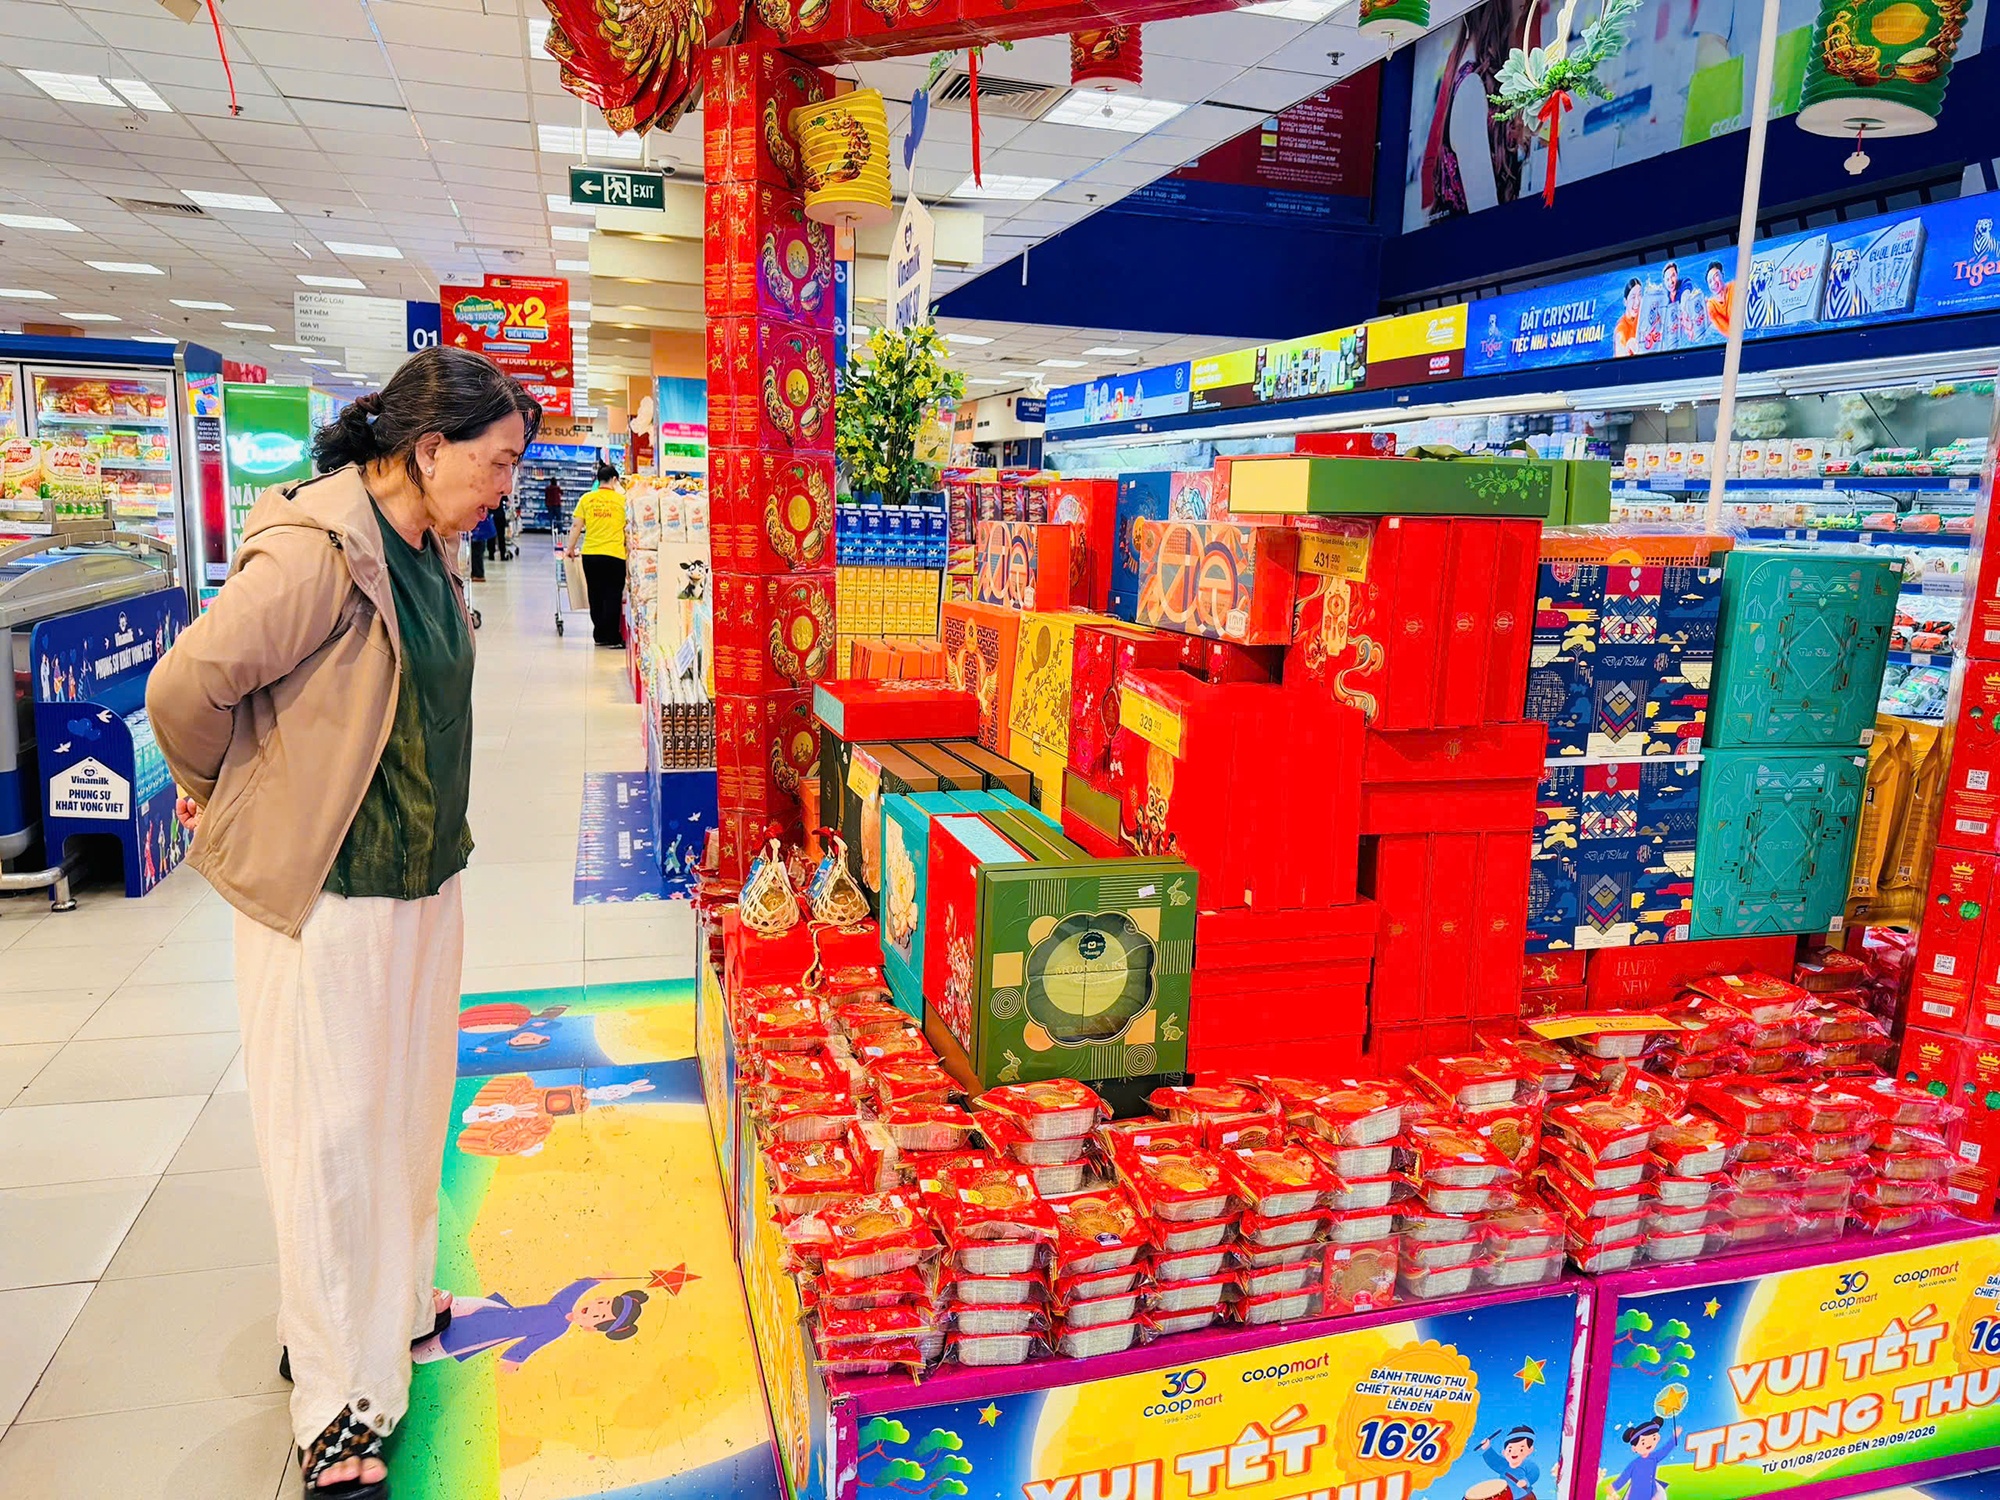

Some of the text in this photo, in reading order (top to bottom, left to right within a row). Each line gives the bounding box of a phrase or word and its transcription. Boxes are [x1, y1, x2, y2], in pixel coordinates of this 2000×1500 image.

[633, 184, 654, 199] EXIT
[1778, 260, 1818, 291] Tiger
[1549, 299, 1596, 328] CRYSTAL!
[413, 328, 438, 349] 01
[199, 443, 221, 452] SDC
[1314, 552, 1329, 568] 431
[1139, 712, 1153, 732] 329
[71, 775, 109, 785] Vinamilk
[1621, 980, 1650, 995] NEW
[1893, 1260, 1960, 1284] co.opmart
[1987, 1275, 2000, 1286] BÁ
[1820, 1293, 1878, 1312] co.opmart
[1728, 1304, 1948, 1403] VUI TẾT
[1241, 1352, 1330, 1384] co.opmart
[1370, 1367, 1467, 1388] BÁNH TRUNG THU
[1161, 1368, 1207, 1398] 30
[1355, 1378, 1390, 1394] CHIẾT
[1390, 1381, 1424, 1398] KHẤU
[1424, 1384, 1448, 1400] HẤP
[1143, 1392, 1223, 1417] co.opmart
[1387, 1397, 1409, 1412] LÊN
[1185, 1412, 1202, 1421] 2026
[1686, 1367, 2000, 1471] TRUNG THU
[1175, 1404, 1326, 1498] TẾT
[1360, 1420, 1441, 1462] 16%
[1780, 1446, 1846, 1470] 01/08/2026
[1871, 1425, 1936, 1449] 29/09/2026
